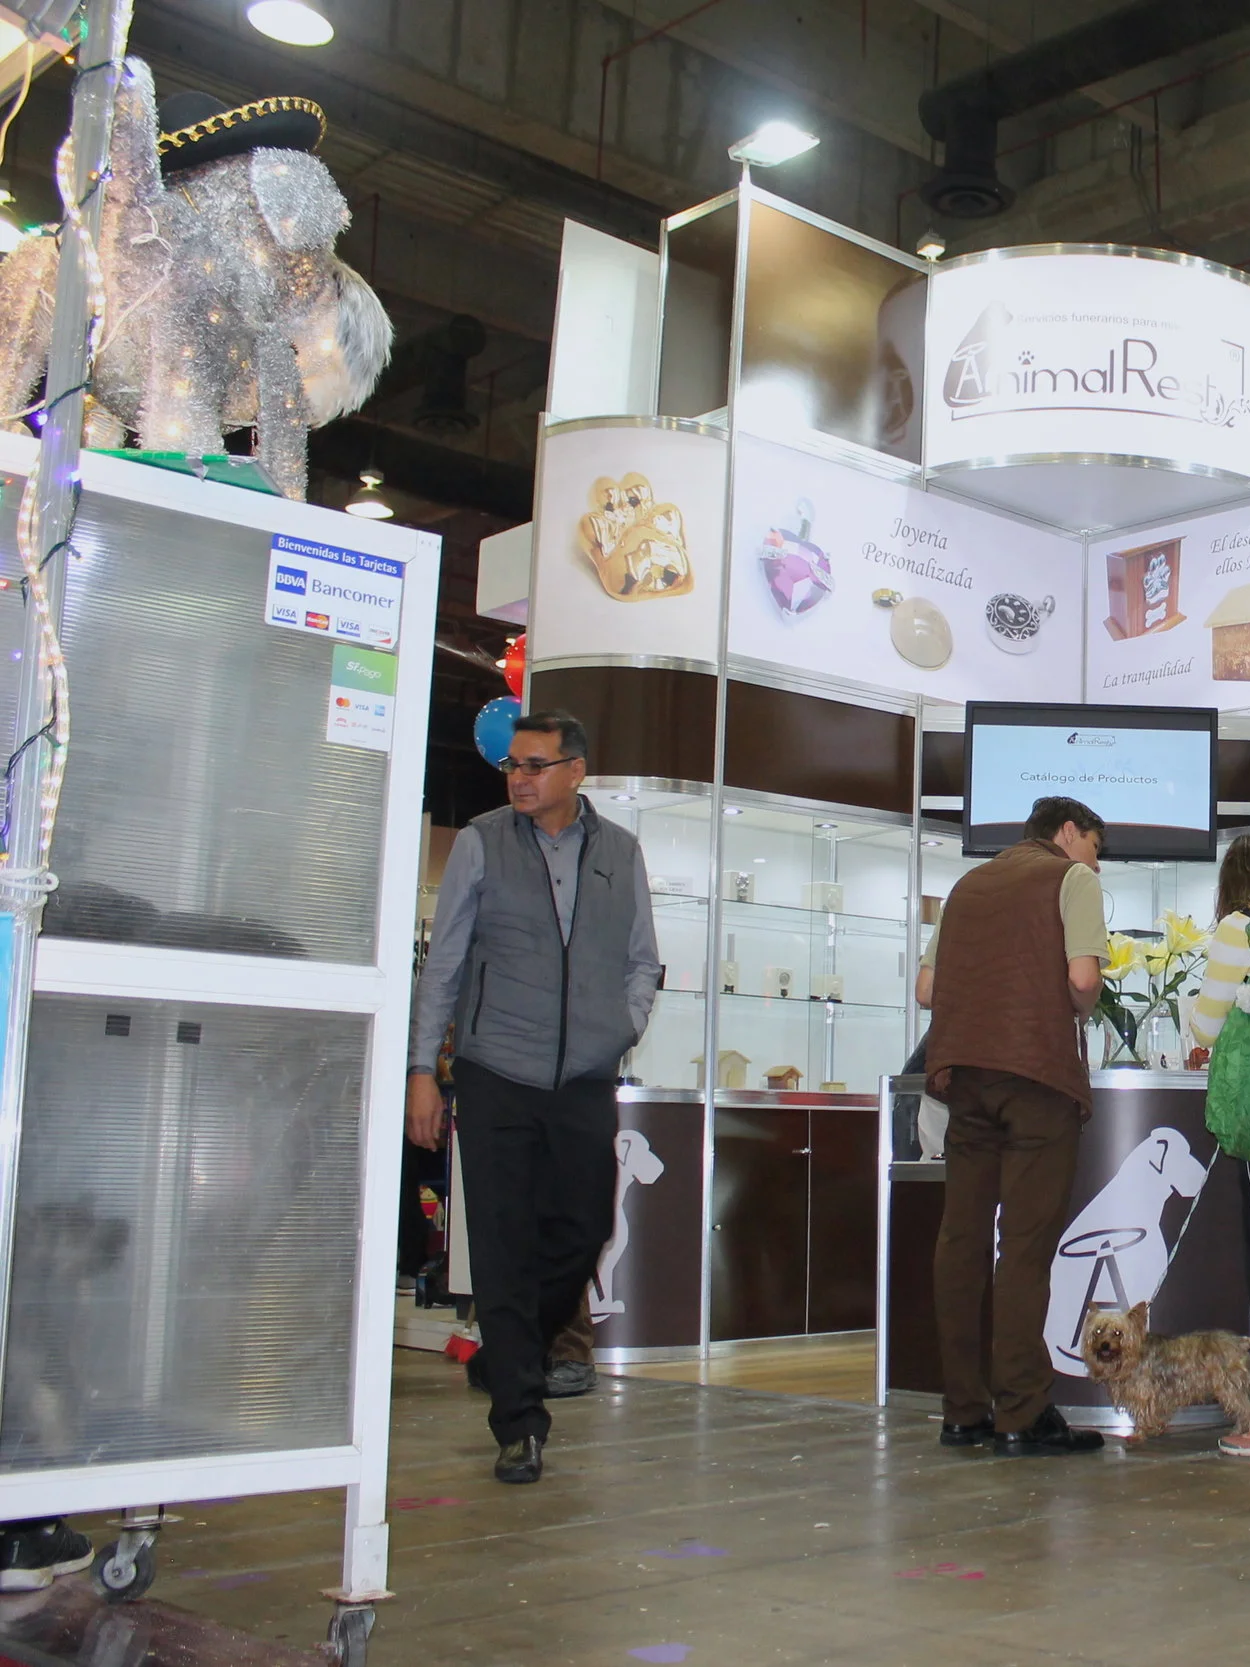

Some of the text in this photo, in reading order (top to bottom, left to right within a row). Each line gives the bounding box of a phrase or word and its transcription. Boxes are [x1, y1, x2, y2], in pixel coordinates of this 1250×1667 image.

[1071, 311, 1129, 325] funerarios
[1132, 316, 1158, 328] para
[890, 517, 948, 550] Joyería
[1210, 533, 1225, 554] El
[277, 536, 398, 575] Bienvenidas las Tarjetas
[861, 541, 974, 590] Personalizada
[1215, 556, 1242, 576] ellos
[276, 572, 395, 608] BBVA Bancomer
[275, 607, 297, 618] VISA
[341, 620, 361, 631] VISA
[1103, 657, 1195, 689] La tranquilidad
[1020, 771, 1158, 785] Catálogo de Productos
